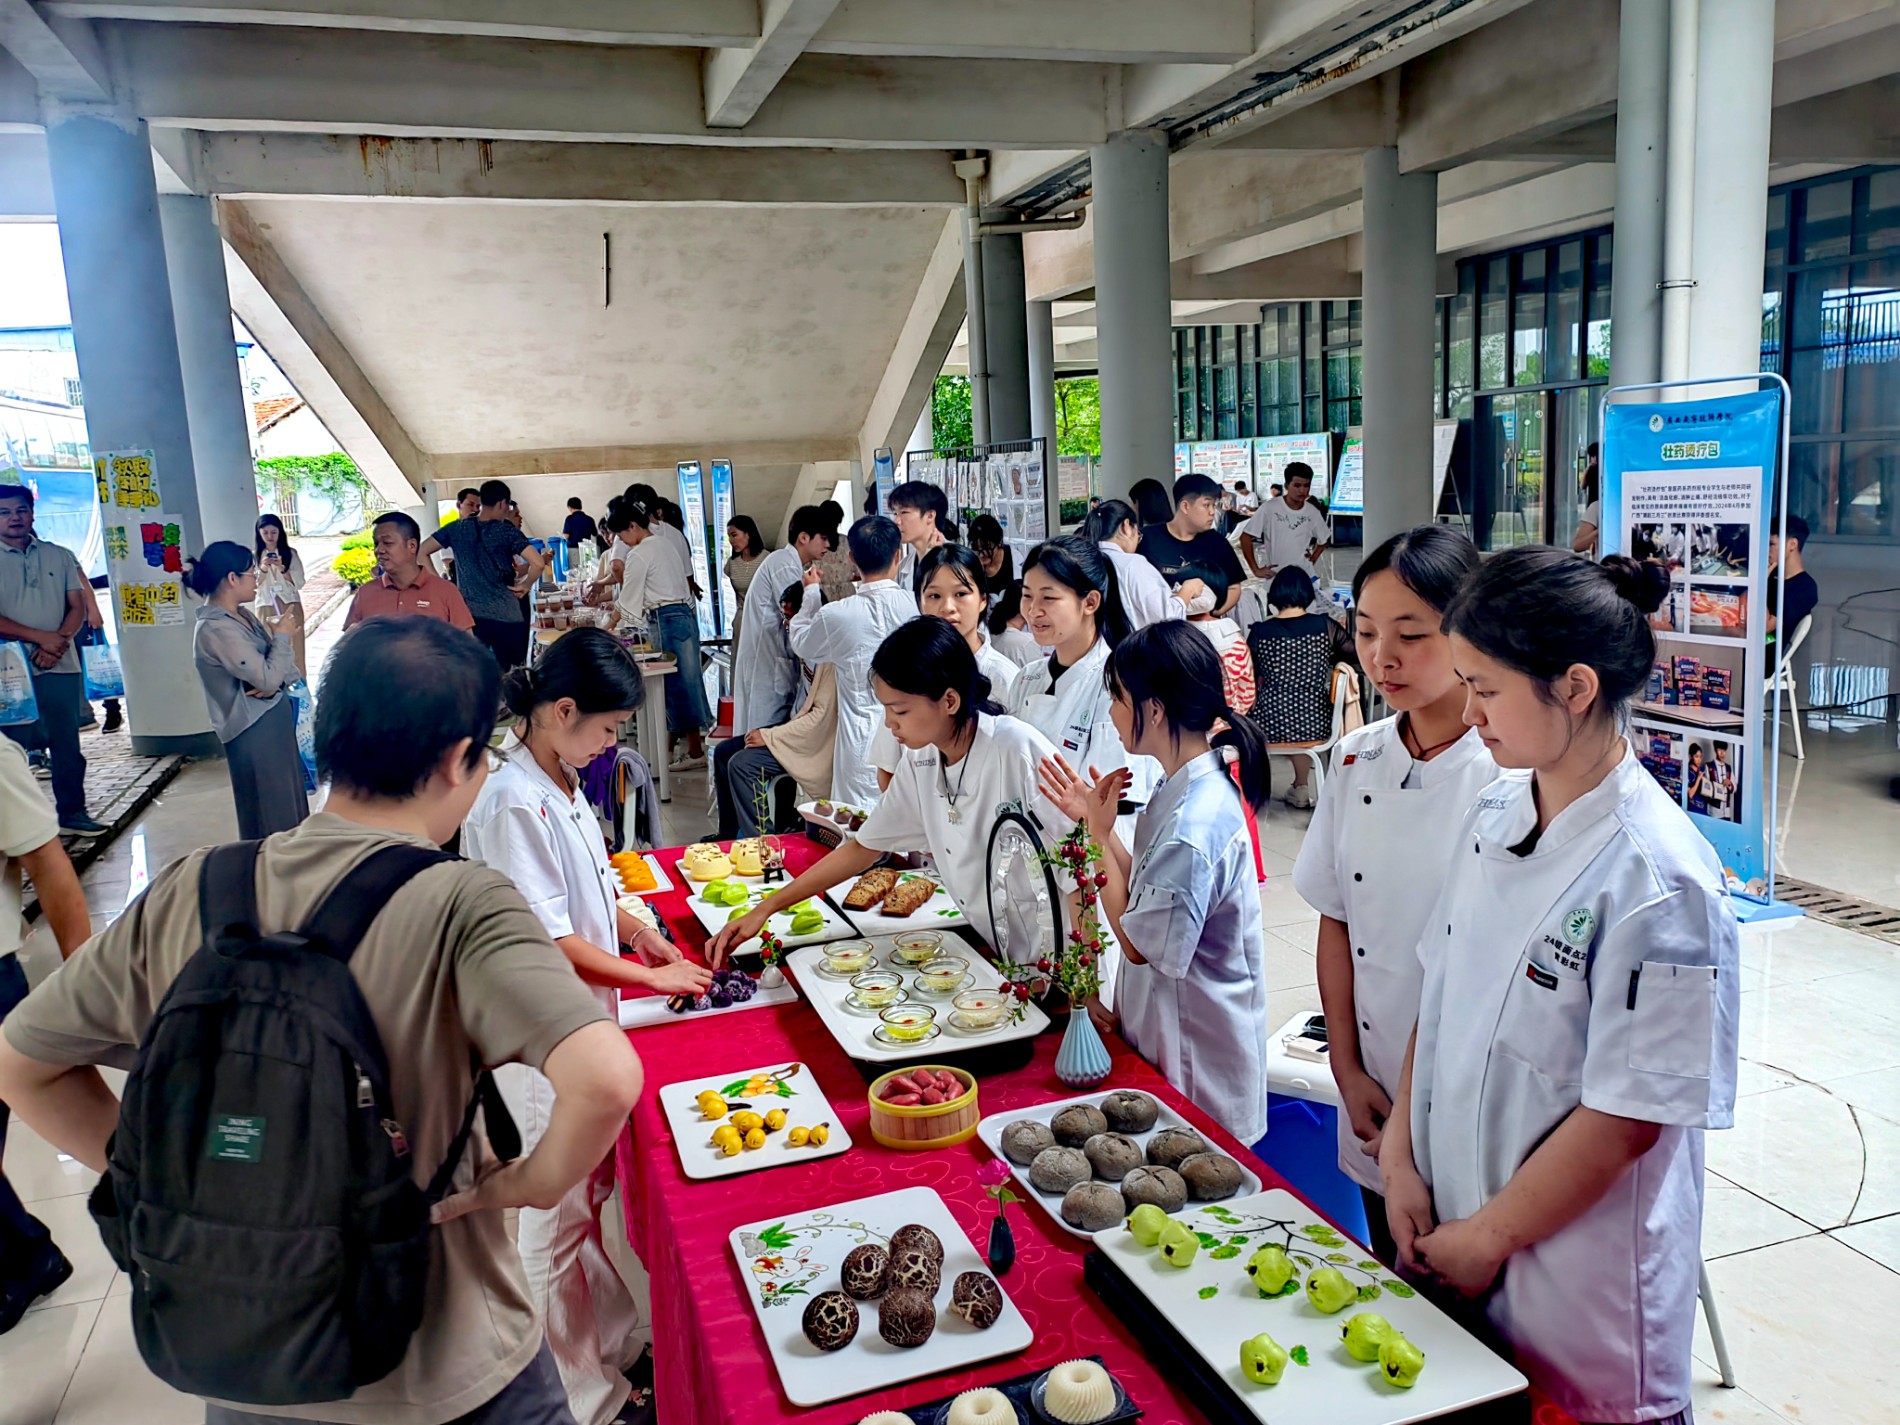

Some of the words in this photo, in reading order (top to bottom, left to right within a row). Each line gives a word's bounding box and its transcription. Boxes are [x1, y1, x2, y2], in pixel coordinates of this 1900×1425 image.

[1661, 441, 1720, 461] 壮药烫疗包
